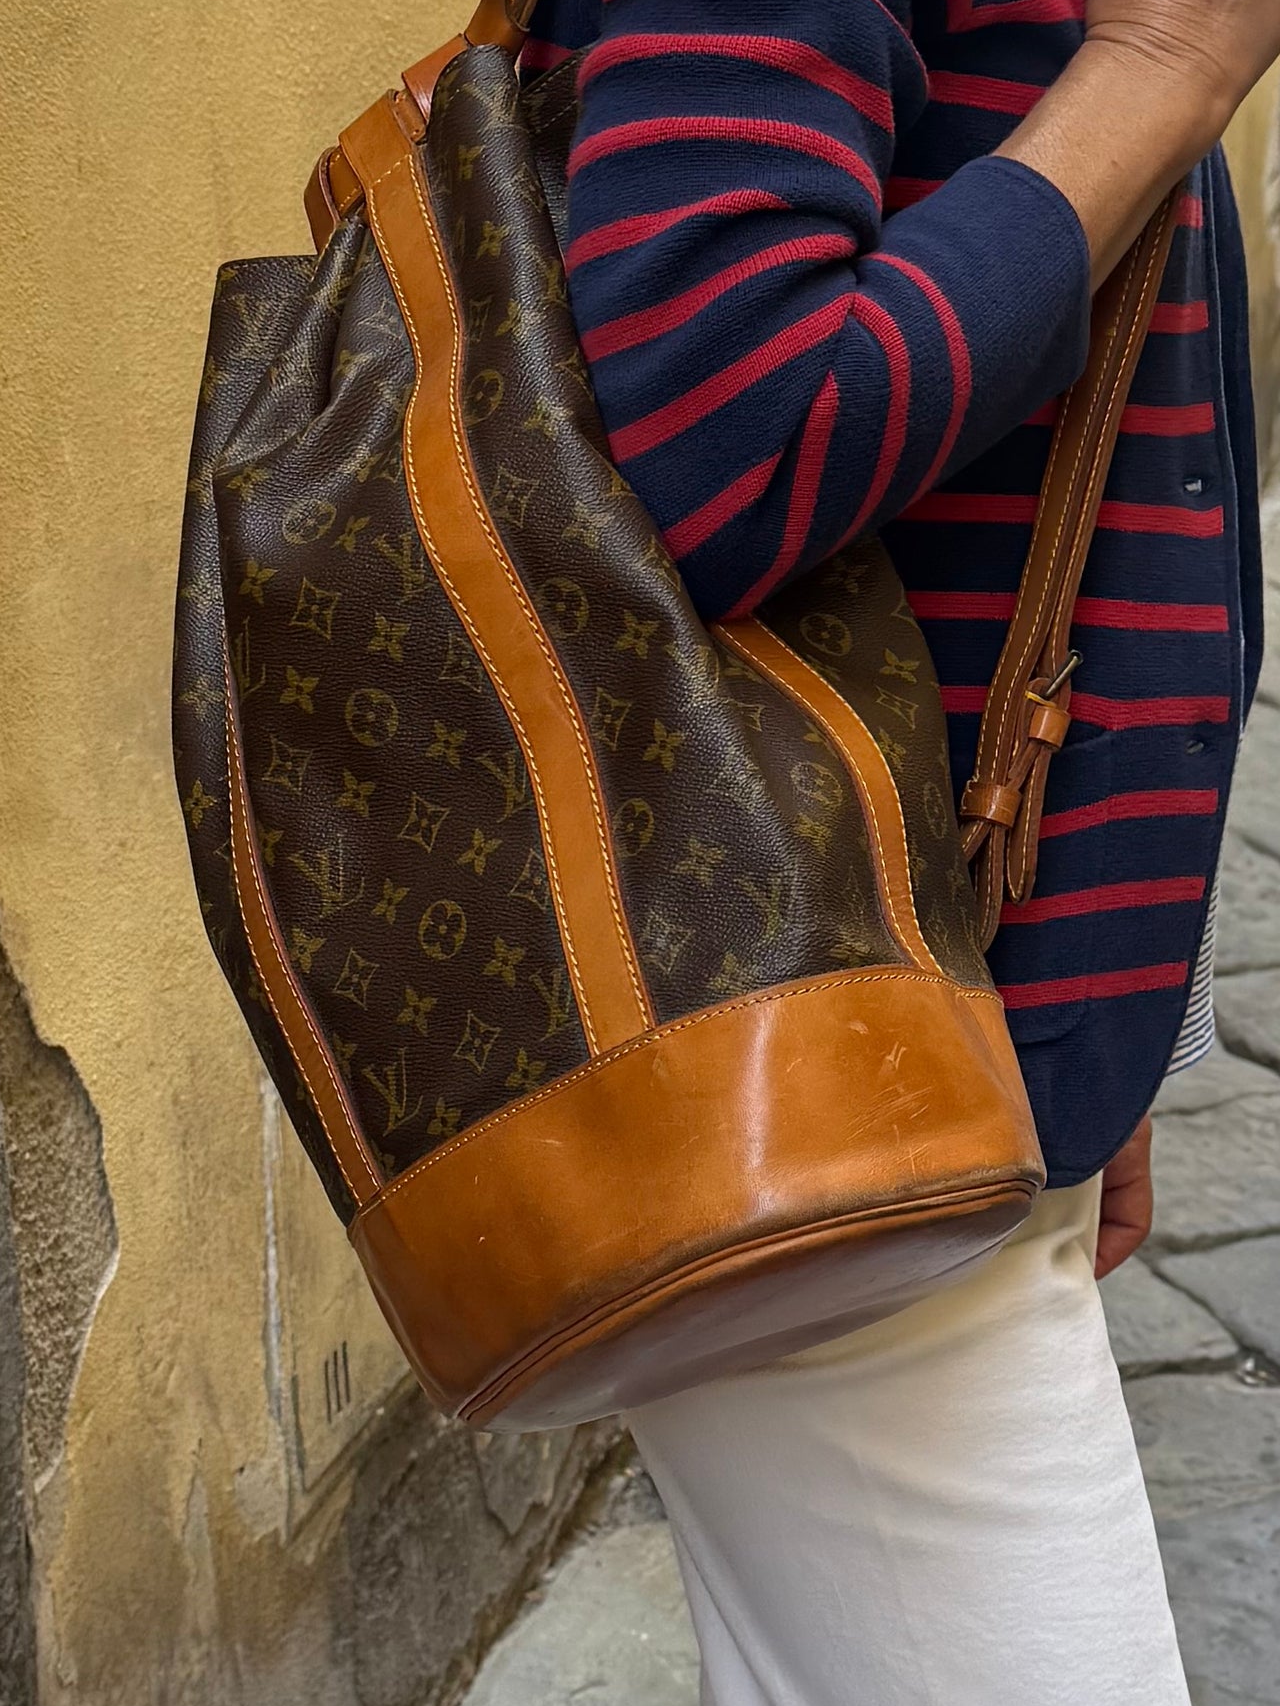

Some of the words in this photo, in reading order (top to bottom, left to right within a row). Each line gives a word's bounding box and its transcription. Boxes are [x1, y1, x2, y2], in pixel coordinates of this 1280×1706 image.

[472, 748, 535, 824] LV
[286, 833, 365, 918] LV
[361, 1045, 424, 1138] LV
